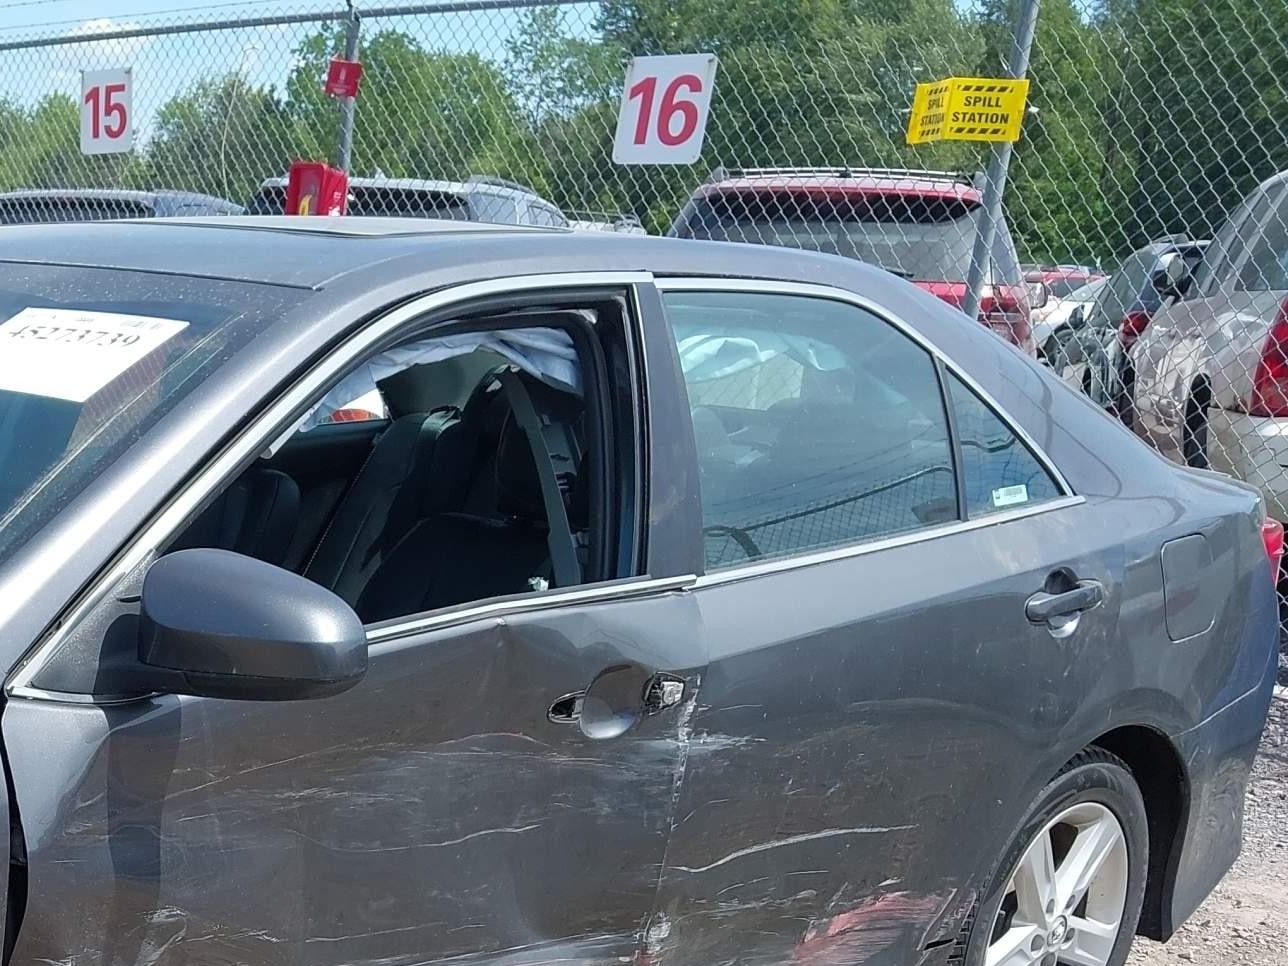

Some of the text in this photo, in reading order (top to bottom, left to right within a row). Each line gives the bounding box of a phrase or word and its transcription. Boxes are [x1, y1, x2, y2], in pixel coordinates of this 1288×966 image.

[84, 84, 127, 139] 15
[628, 74, 703, 147] 16
[952, 111, 1009, 124] STATION
[964, 95, 1002, 108] SPILL
